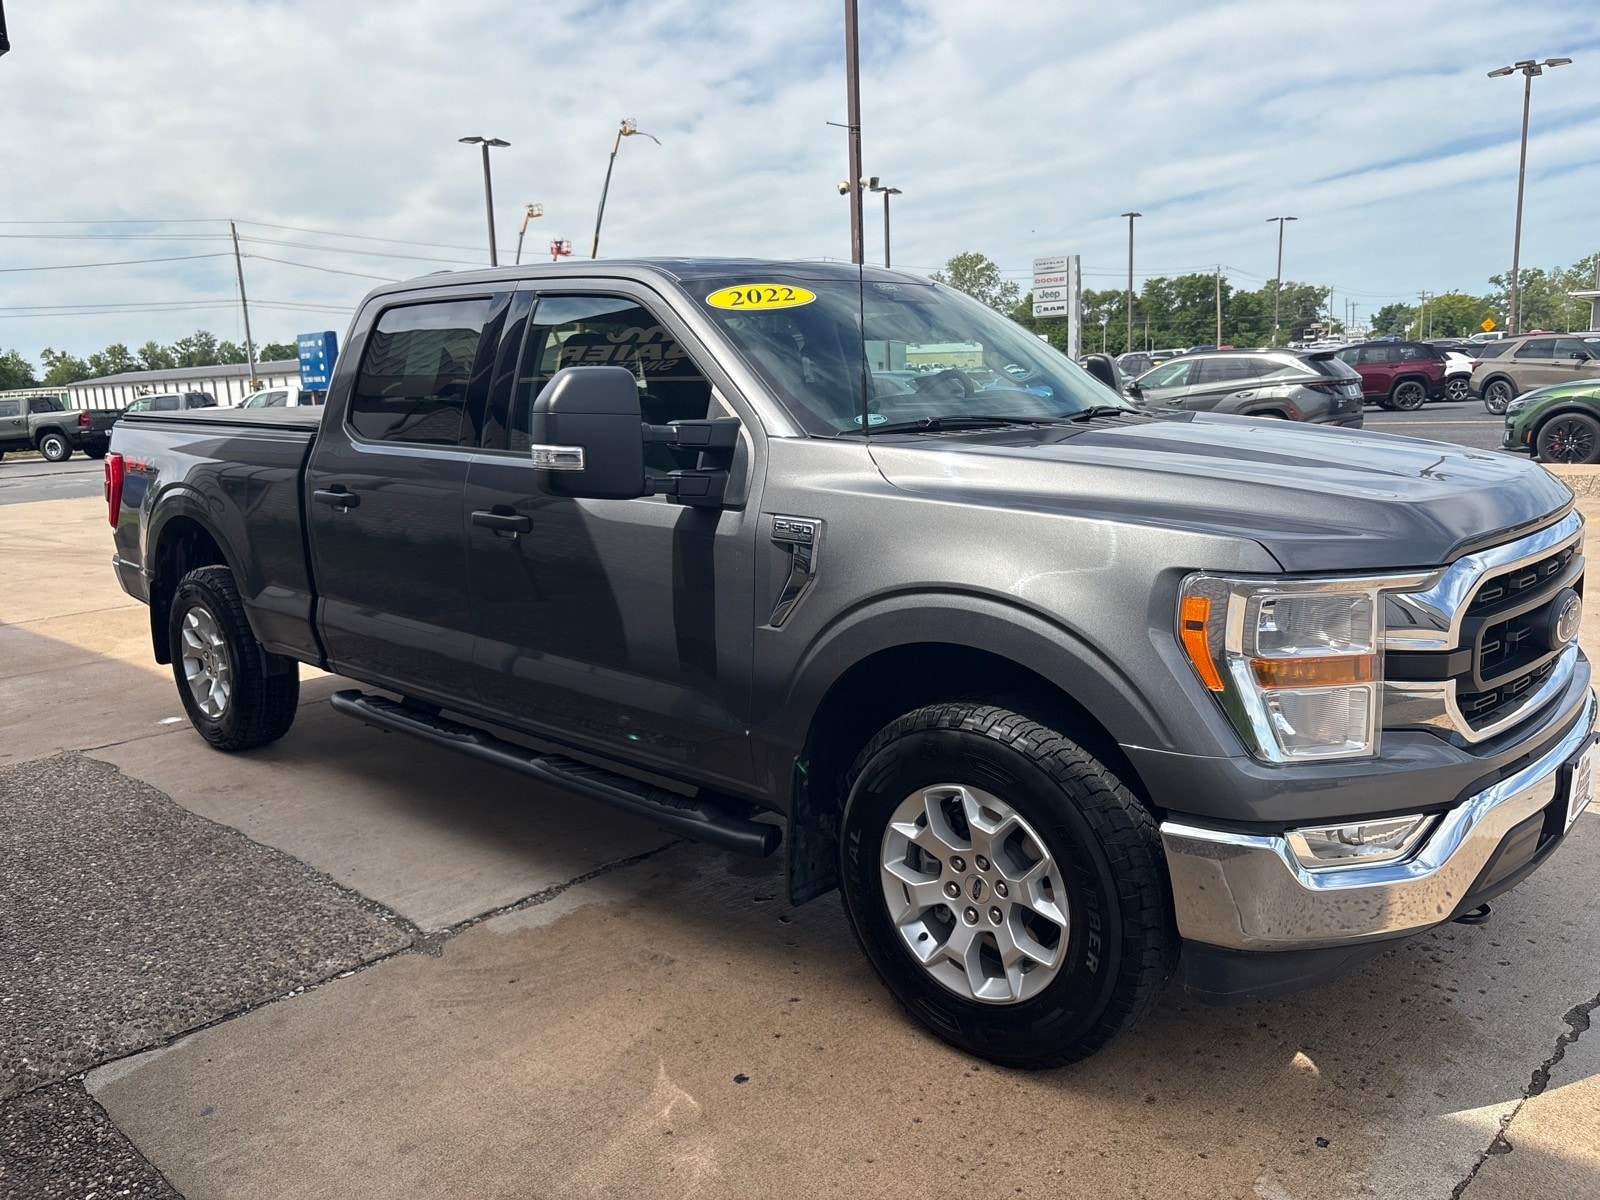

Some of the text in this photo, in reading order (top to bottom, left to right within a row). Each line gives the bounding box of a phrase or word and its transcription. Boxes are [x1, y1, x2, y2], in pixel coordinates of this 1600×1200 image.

[1034, 276, 1065, 284] DODGE
[728, 287, 796, 307] 2022
[1039, 290, 1060, 300] Jeep
